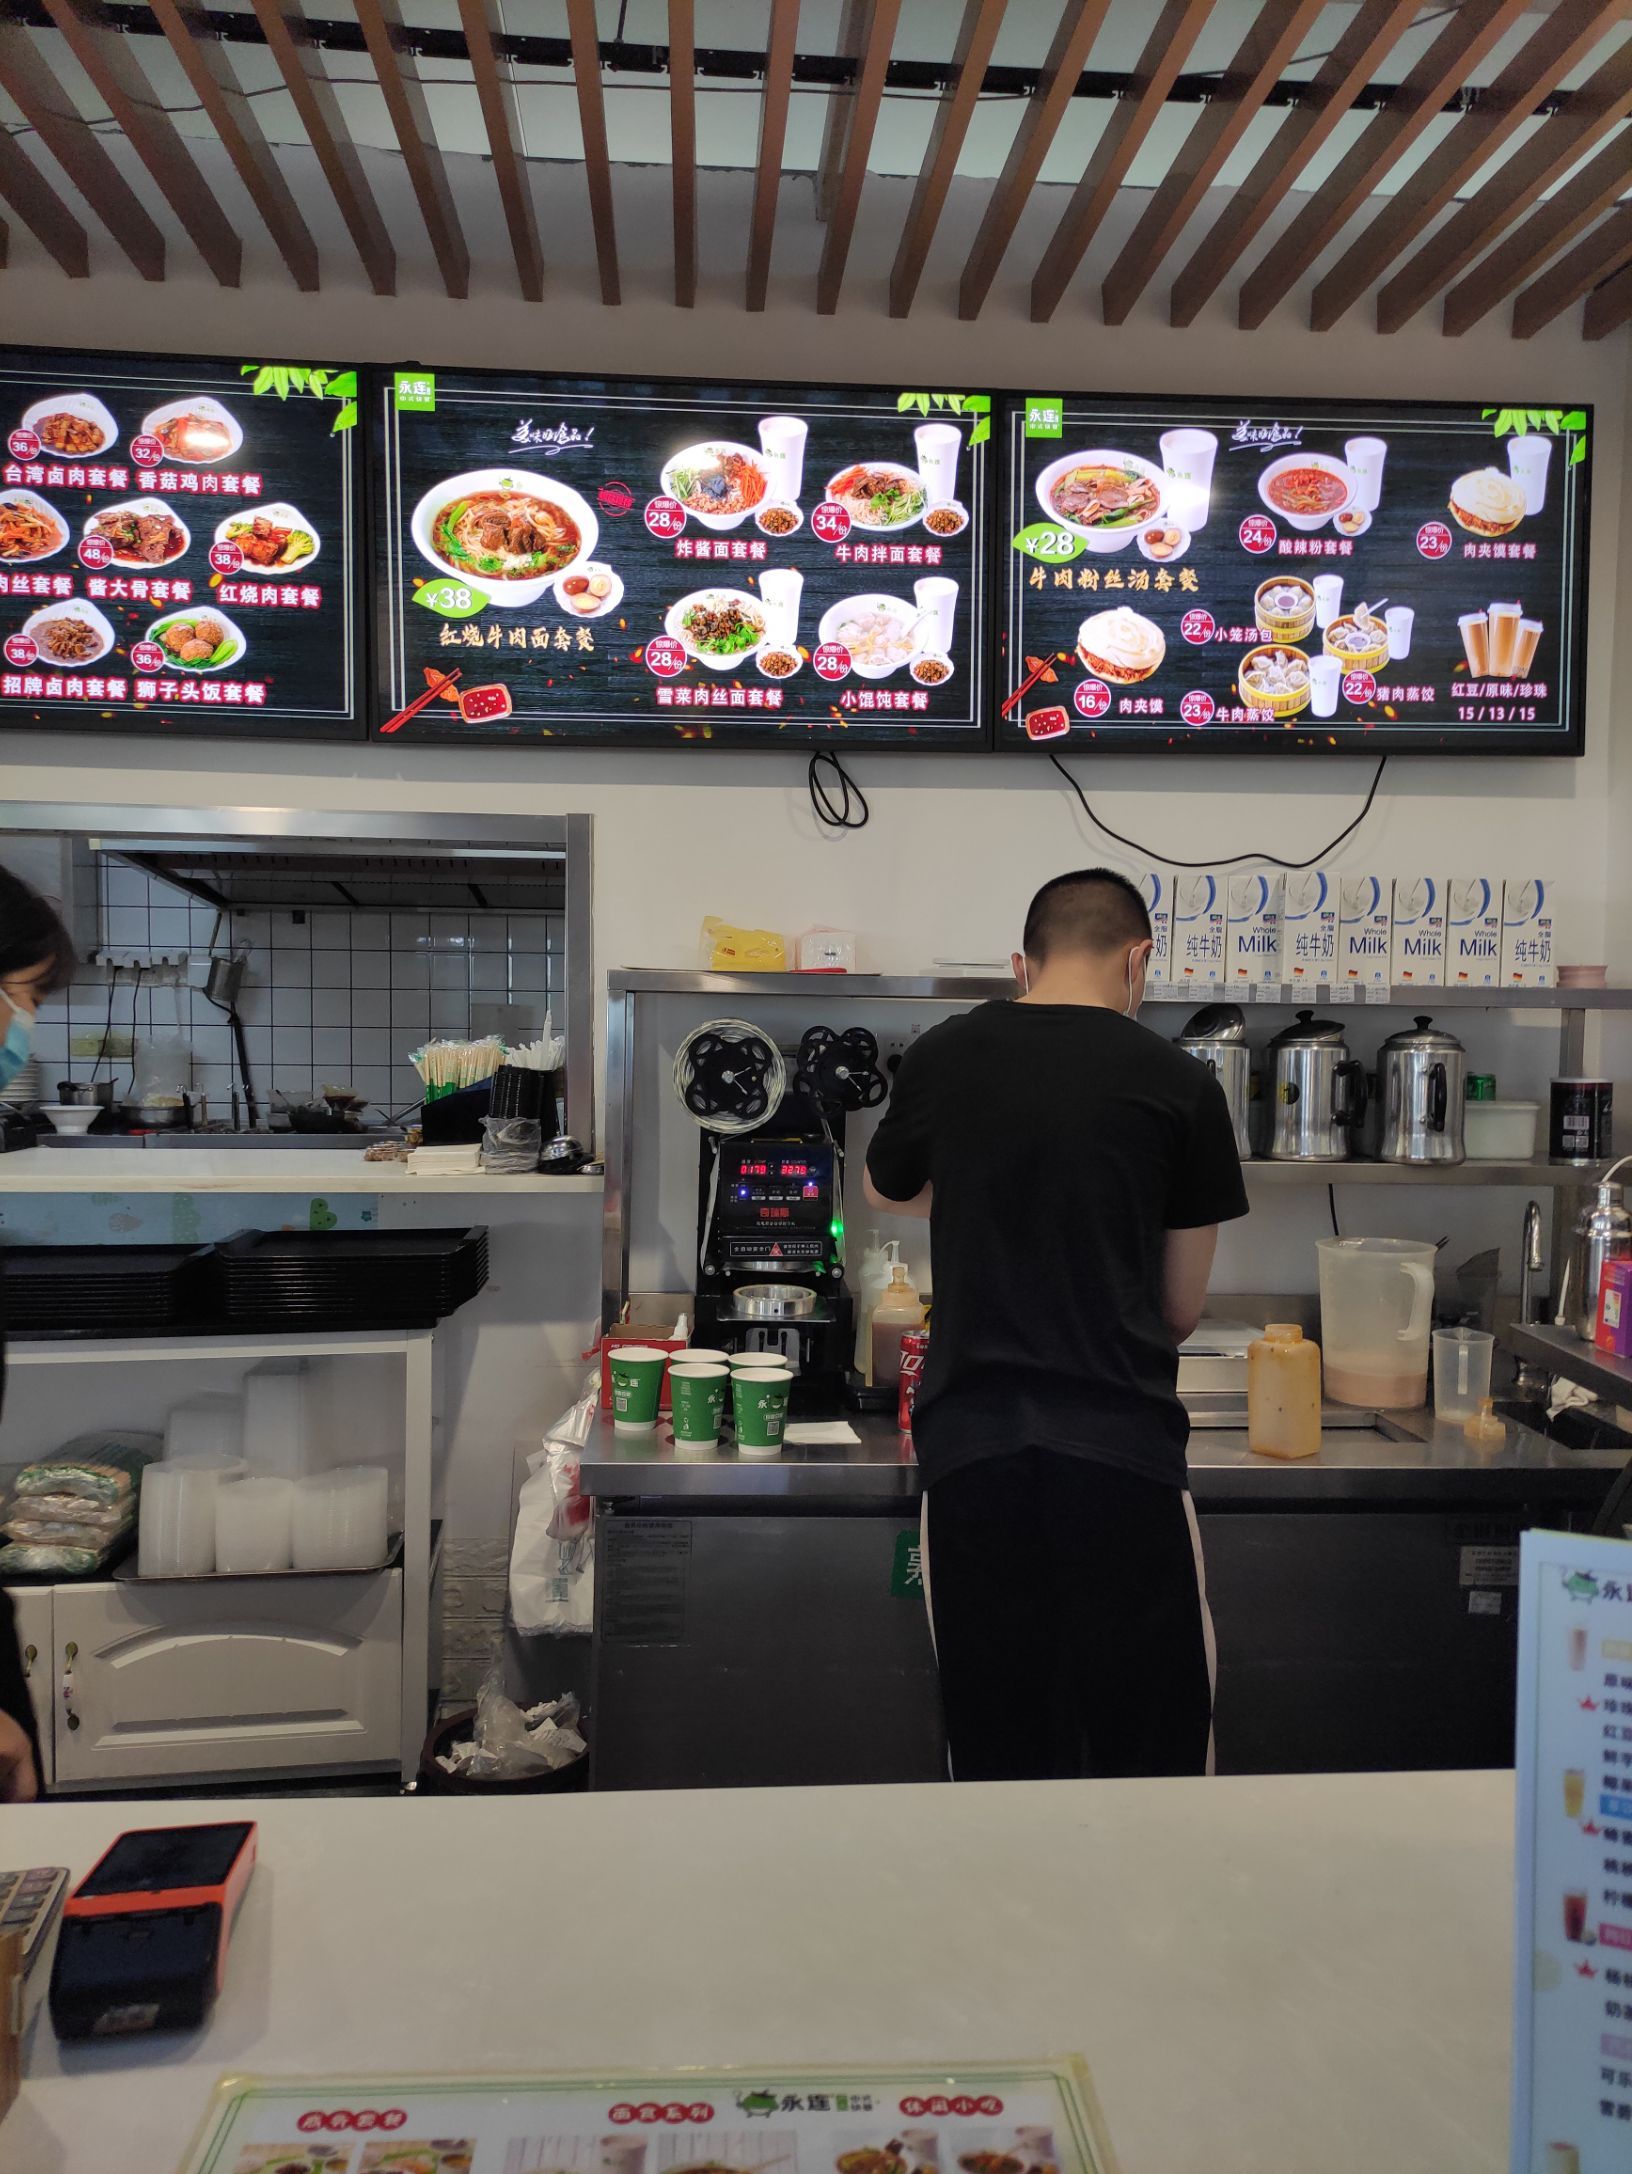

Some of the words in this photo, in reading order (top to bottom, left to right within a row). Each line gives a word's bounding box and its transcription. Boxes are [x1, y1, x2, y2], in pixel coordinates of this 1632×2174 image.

[4, 463, 128, 488] 台湾卤肉套餐
[138, 470, 261, 495] 香菇鸡肉套餐
[676, 540, 767, 560] 炸酱面套餐
[835, 544, 942, 564] 牛肉拌面套餐
[1025, 532, 1075, 555] ¥28
[1278, 539, 1354, 555] 酸辣粉套餐
[88, 577, 192, 600] 酱大骨套餐
[1029, 565, 1200, 593] 牛肉粉丝汤套餐
[219, 584, 320, 606] 红烧肉套餐
[426, 588, 472, 609] ¥38
[439, 623, 595, 652] 红烧牛肉面套餐
[1214, 627, 1273, 643] 小笼汤包
[3, 675, 126, 698] 招牌卤肉套餐
[137, 680, 264, 704] 狮子头饭套餐
[1376, 686, 1435, 702] 猪肉蒸饺
[1451, 682, 1548, 698] 红豆/原味/珍珠
[656, 687, 783, 708] 雪菜肉丝面套餐
[840, 690, 929, 710] 小馄饨套餐
[1119, 699, 1164, 714] 肉夹馍
[1215, 707, 1275, 722] 牛肉蒸饺
[1186, 933, 1222, 958] 纯牛奶
[1238, 935, 1277, 953] Milk
[1296, 933, 1334, 957] 纯牛奶
[1350, 936, 1387, 955] Milk
[1404, 938, 1442, 956] Milk
[1460, 938, 1497, 956] Milk
[1515, 939, 1551, 962] 纯牛奶
